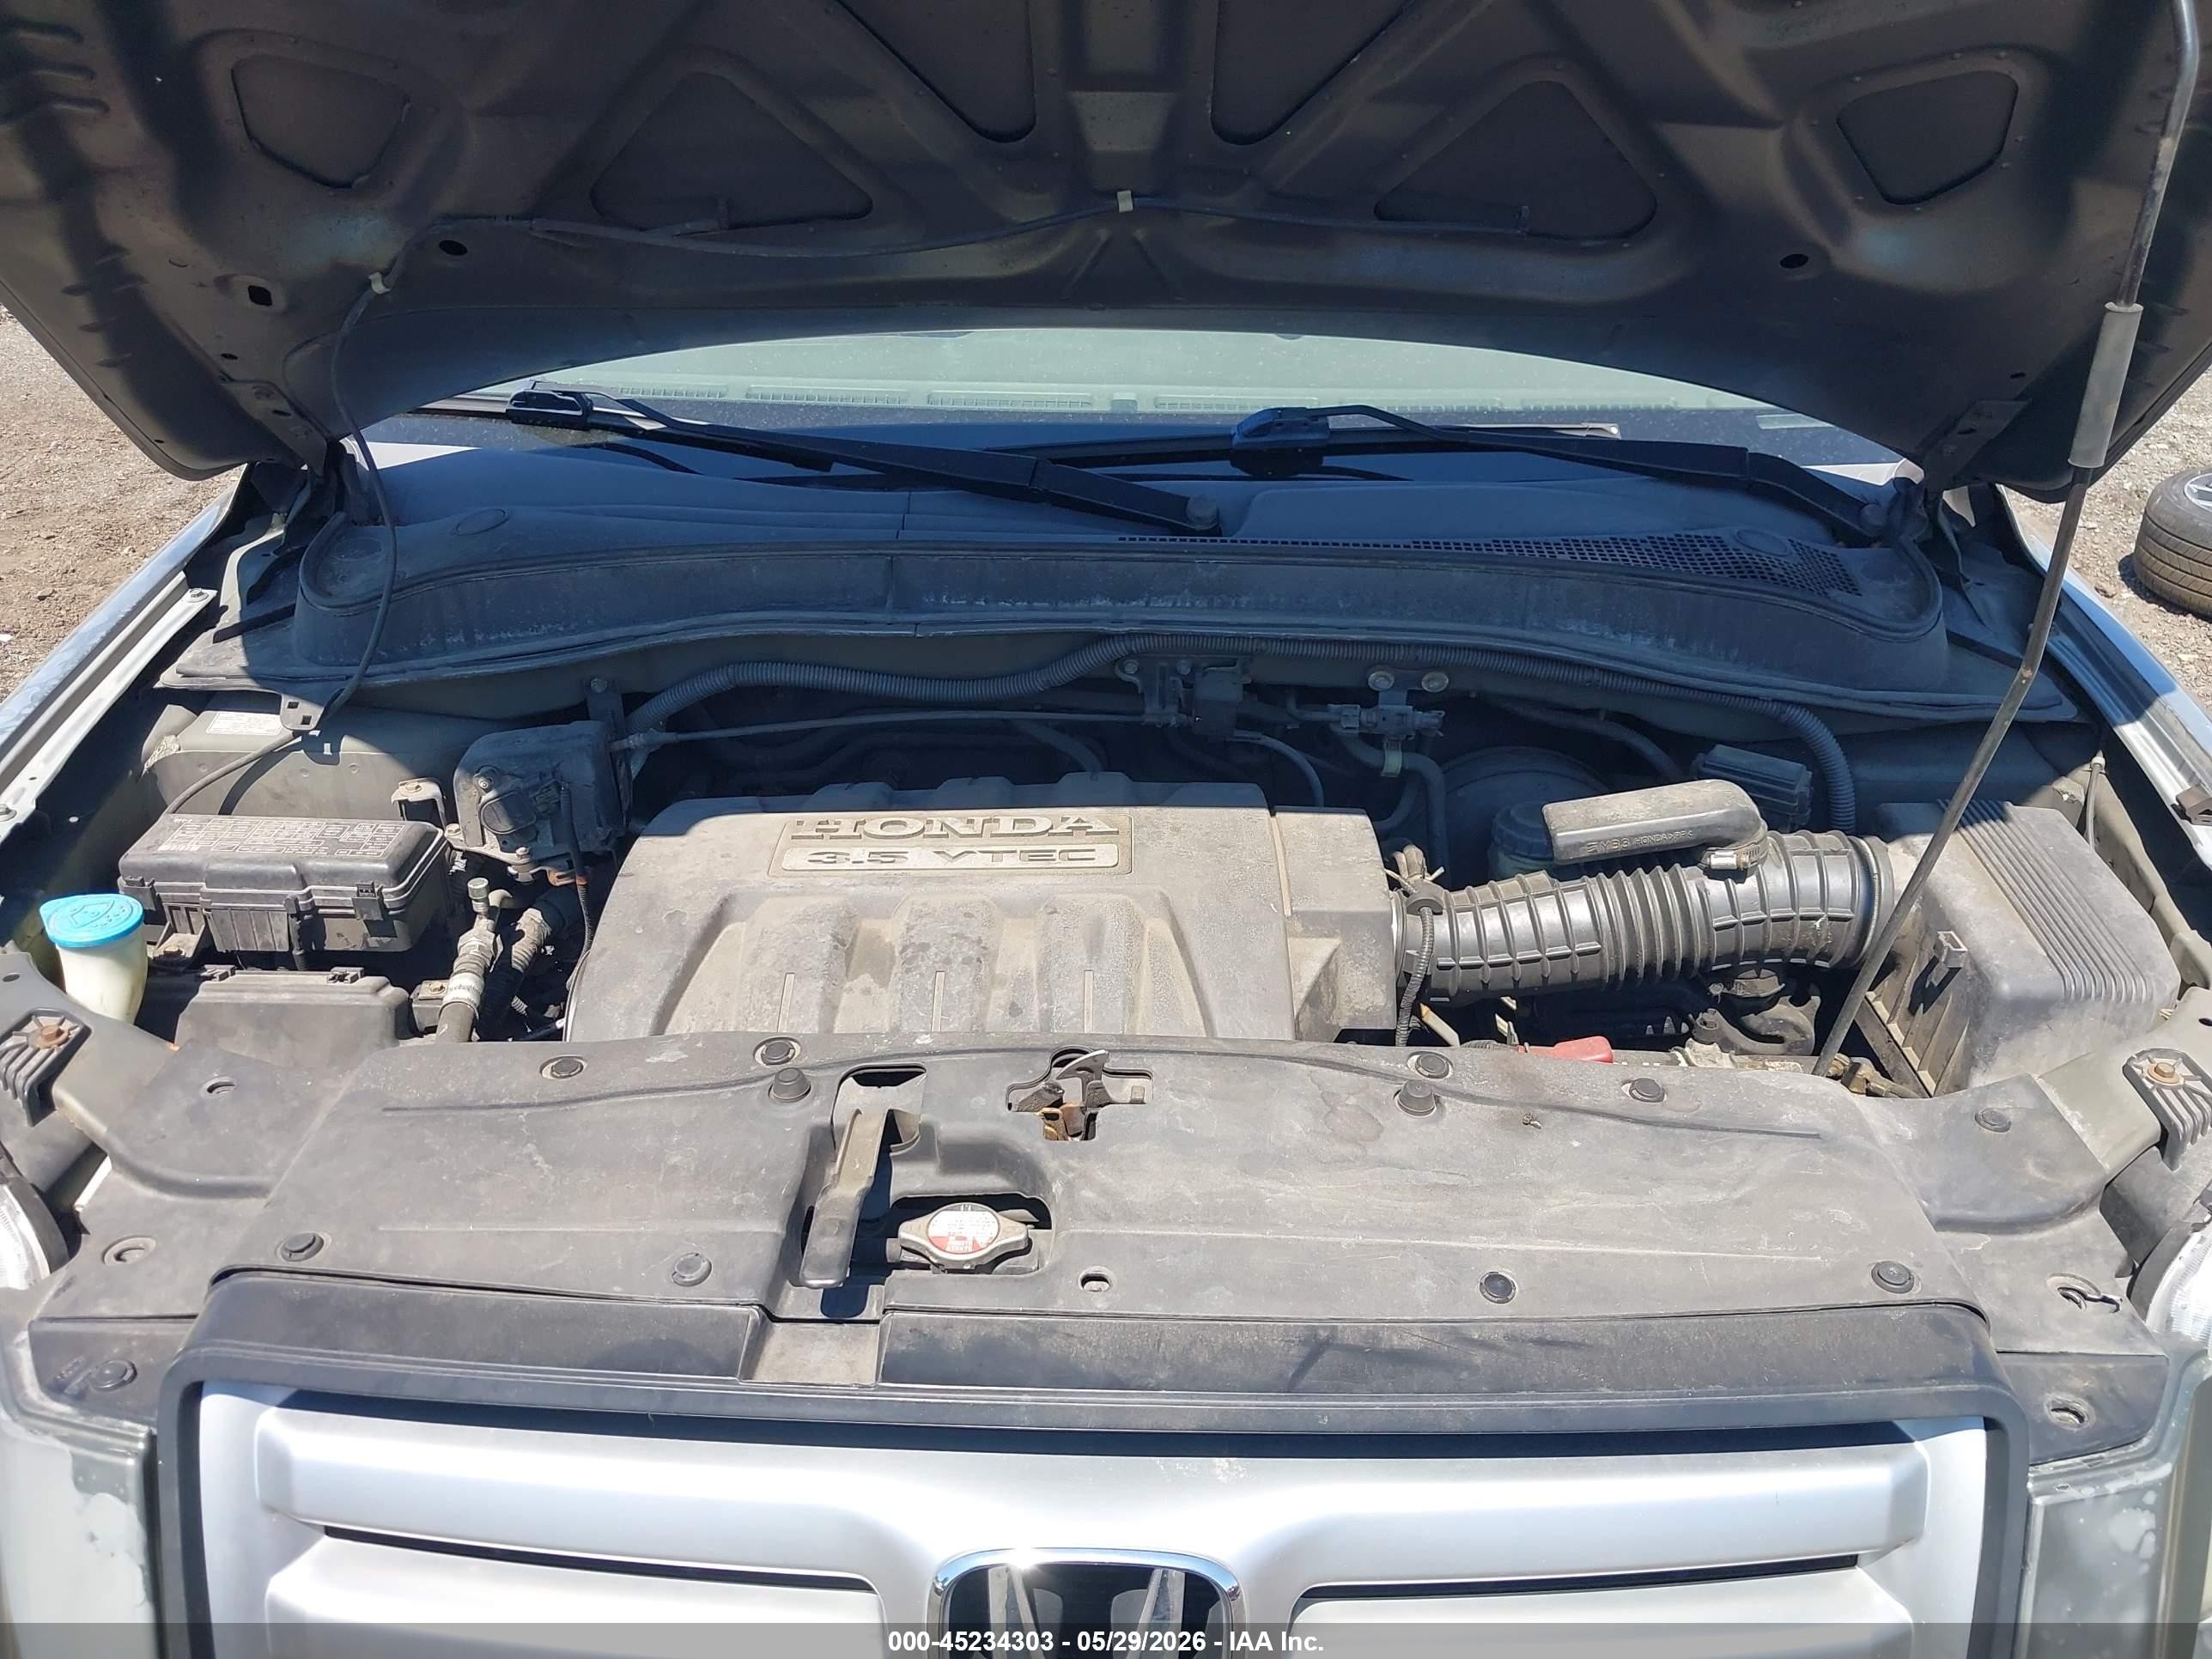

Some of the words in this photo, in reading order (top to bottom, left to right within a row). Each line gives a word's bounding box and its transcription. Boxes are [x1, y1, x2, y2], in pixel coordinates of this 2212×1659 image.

[791, 816, 1119, 840] HONDA
[807, 850, 909, 864] 3.5
[933, 848, 1096, 863] VTEC
